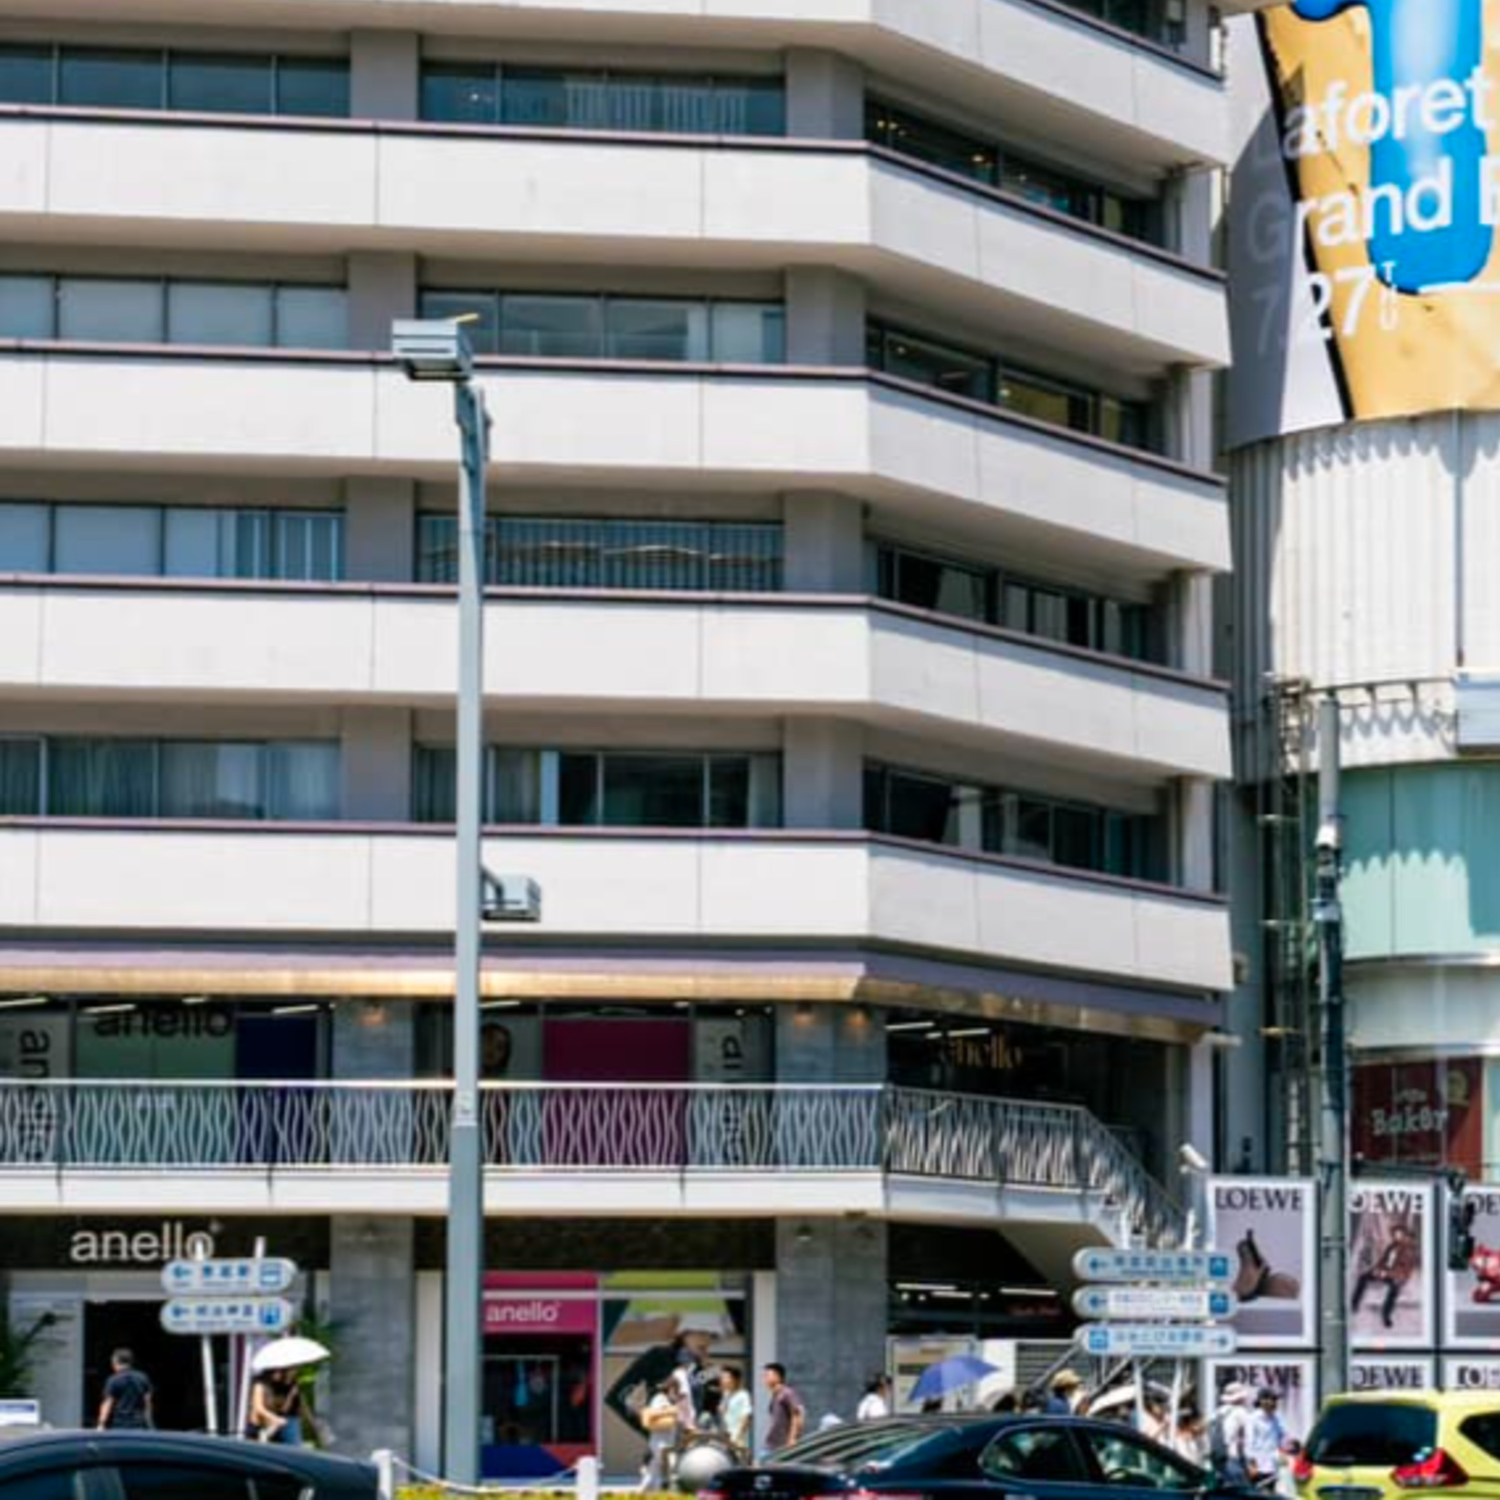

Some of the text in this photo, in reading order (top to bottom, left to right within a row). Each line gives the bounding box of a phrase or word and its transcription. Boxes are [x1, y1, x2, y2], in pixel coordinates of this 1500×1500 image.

[1215, 1186, 1301, 1211] LOEWE
[1347, 1189, 1424, 1214] OEWE
[69, 1221, 215, 1262] anello
[486, 1301, 559, 1322] anello
[1351, 1365, 1424, 1389] OEWE
